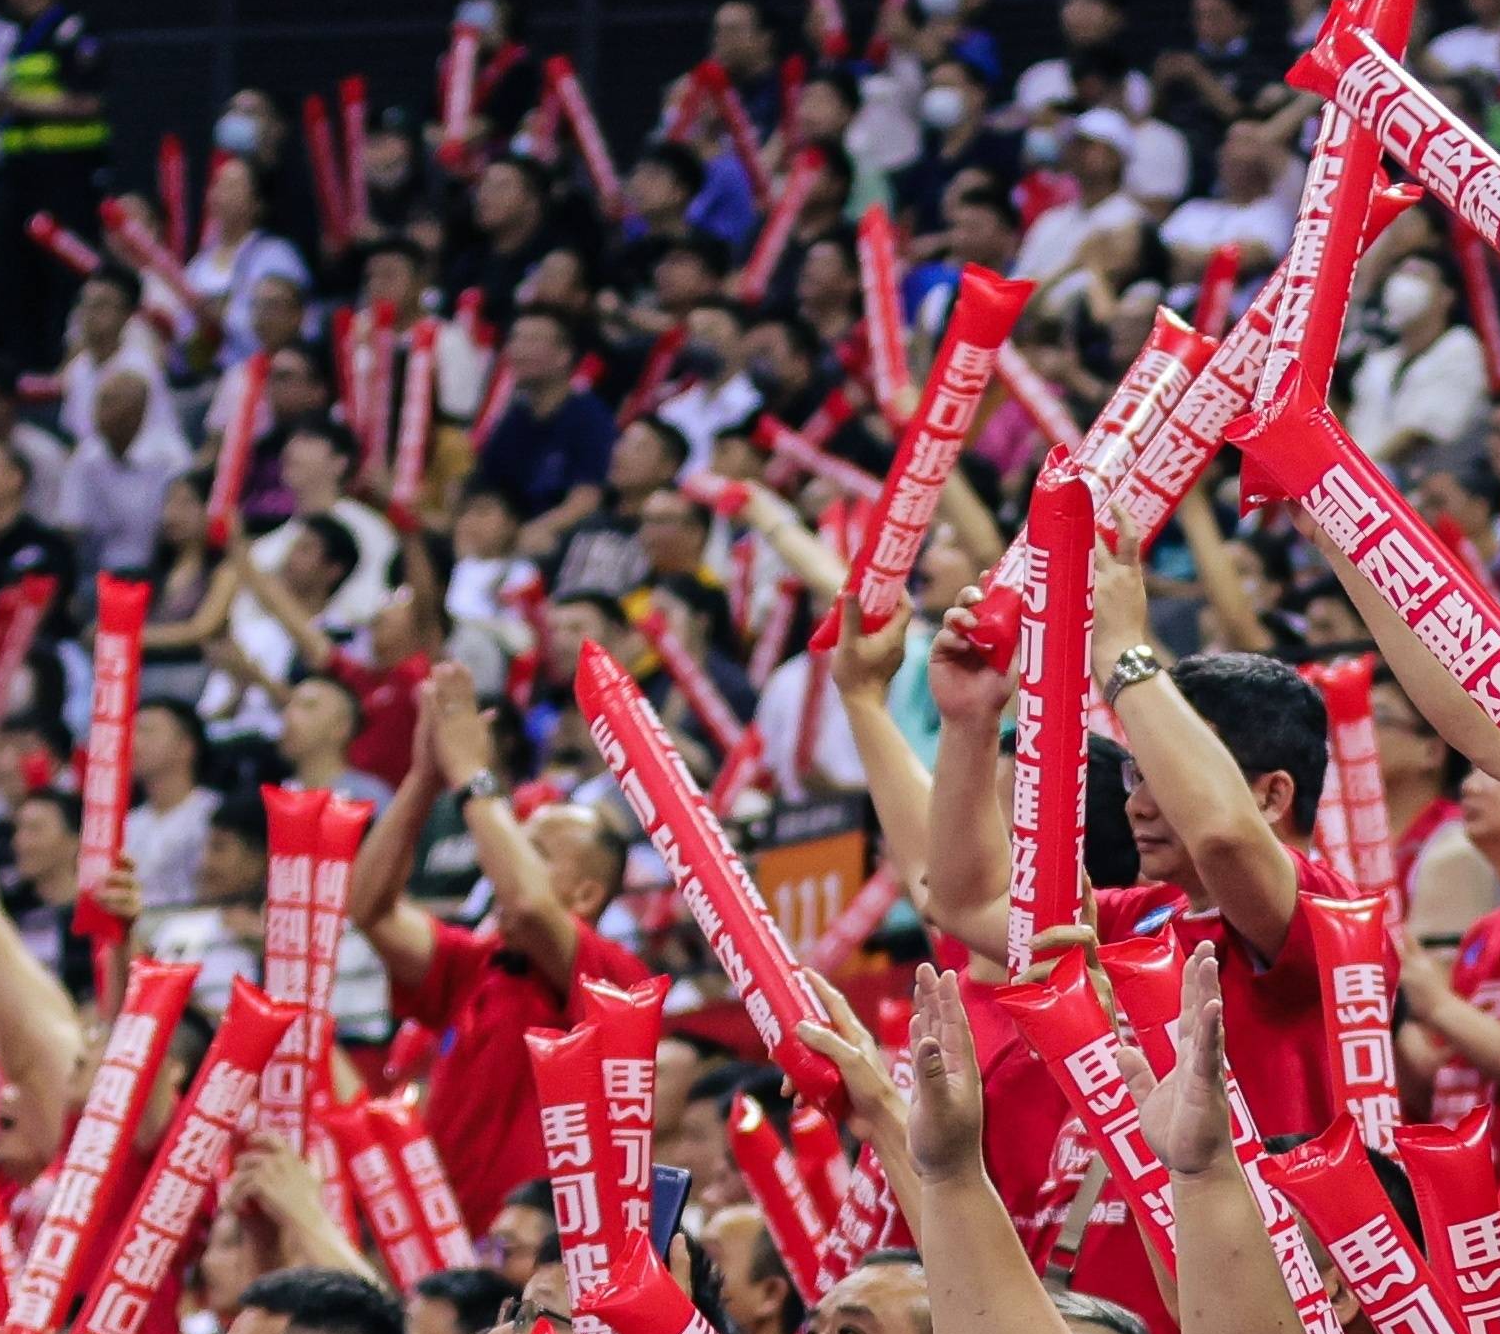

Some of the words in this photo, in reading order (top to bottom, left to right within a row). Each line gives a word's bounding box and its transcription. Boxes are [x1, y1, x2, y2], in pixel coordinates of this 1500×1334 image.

[858, 341, 999, 617] 馬可波羅磁磚
[1332, 963, 1402, 1157] 馬可波
